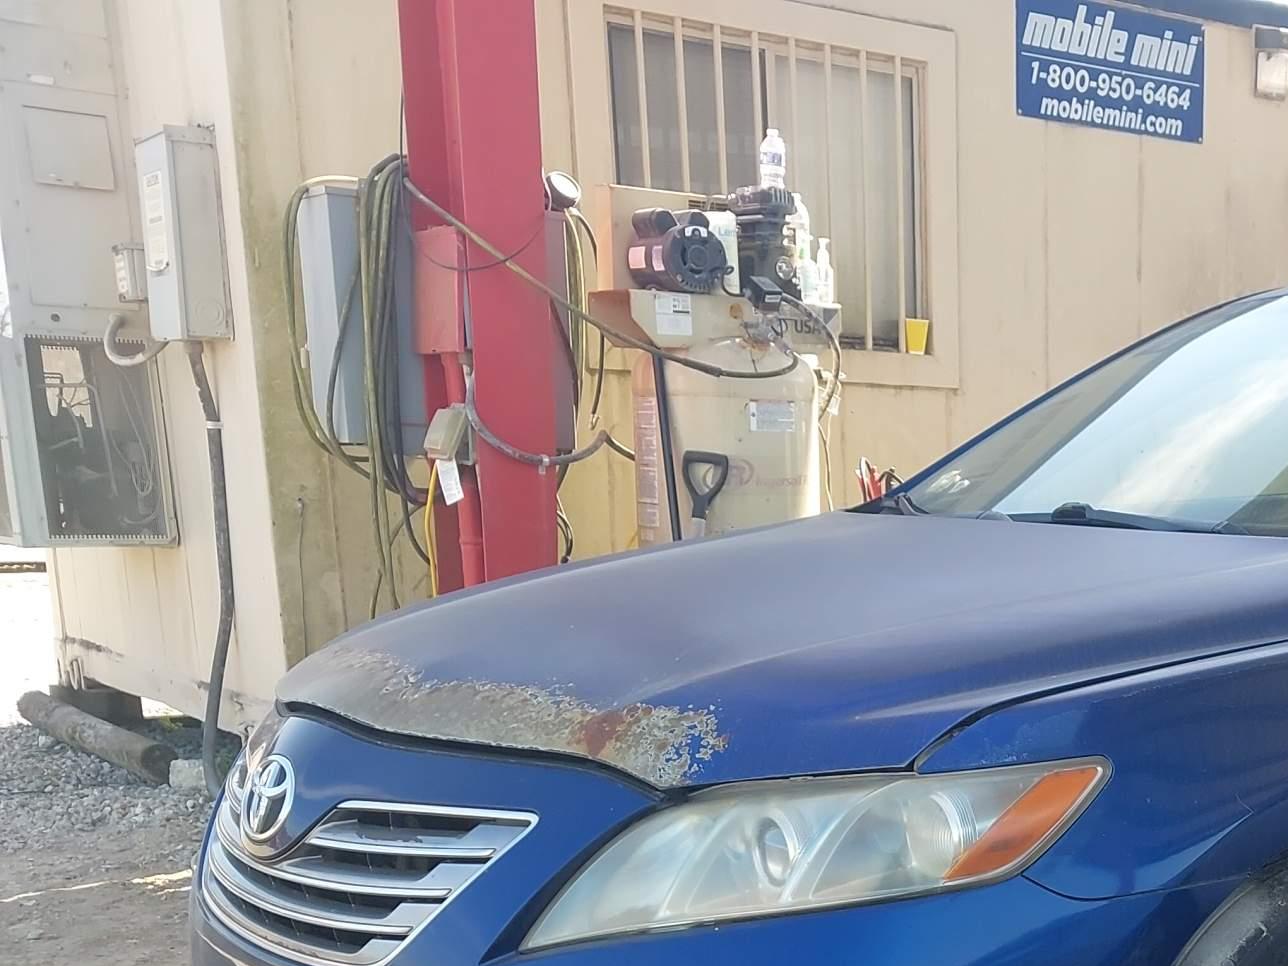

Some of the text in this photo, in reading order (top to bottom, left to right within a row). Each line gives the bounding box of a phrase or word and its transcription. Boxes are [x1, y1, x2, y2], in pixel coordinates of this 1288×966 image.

[1022, 5, 1200, 75] mobile mini
[1031, 61, 1190, 110] 1-800-950-6464
[1040, 97, 1182, 136] mobilemini.com
